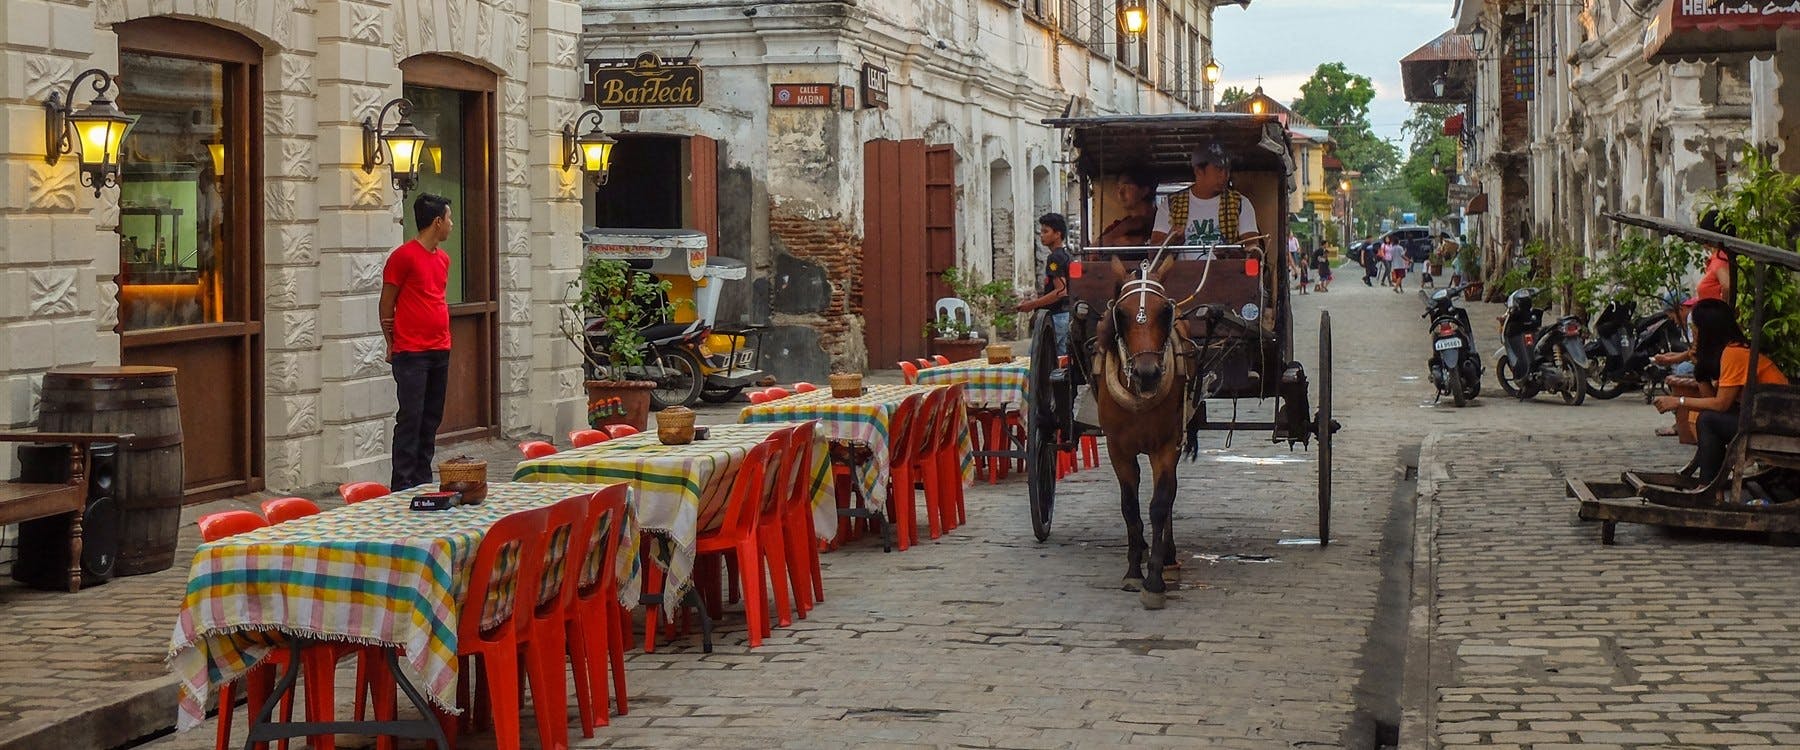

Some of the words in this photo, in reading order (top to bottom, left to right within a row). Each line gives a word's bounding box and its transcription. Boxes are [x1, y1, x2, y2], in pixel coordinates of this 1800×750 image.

[602, 74, 694, 104] BarTech
[799, 86, 819, 94] CALLE
[797, 95, 824, 105] MABINI
